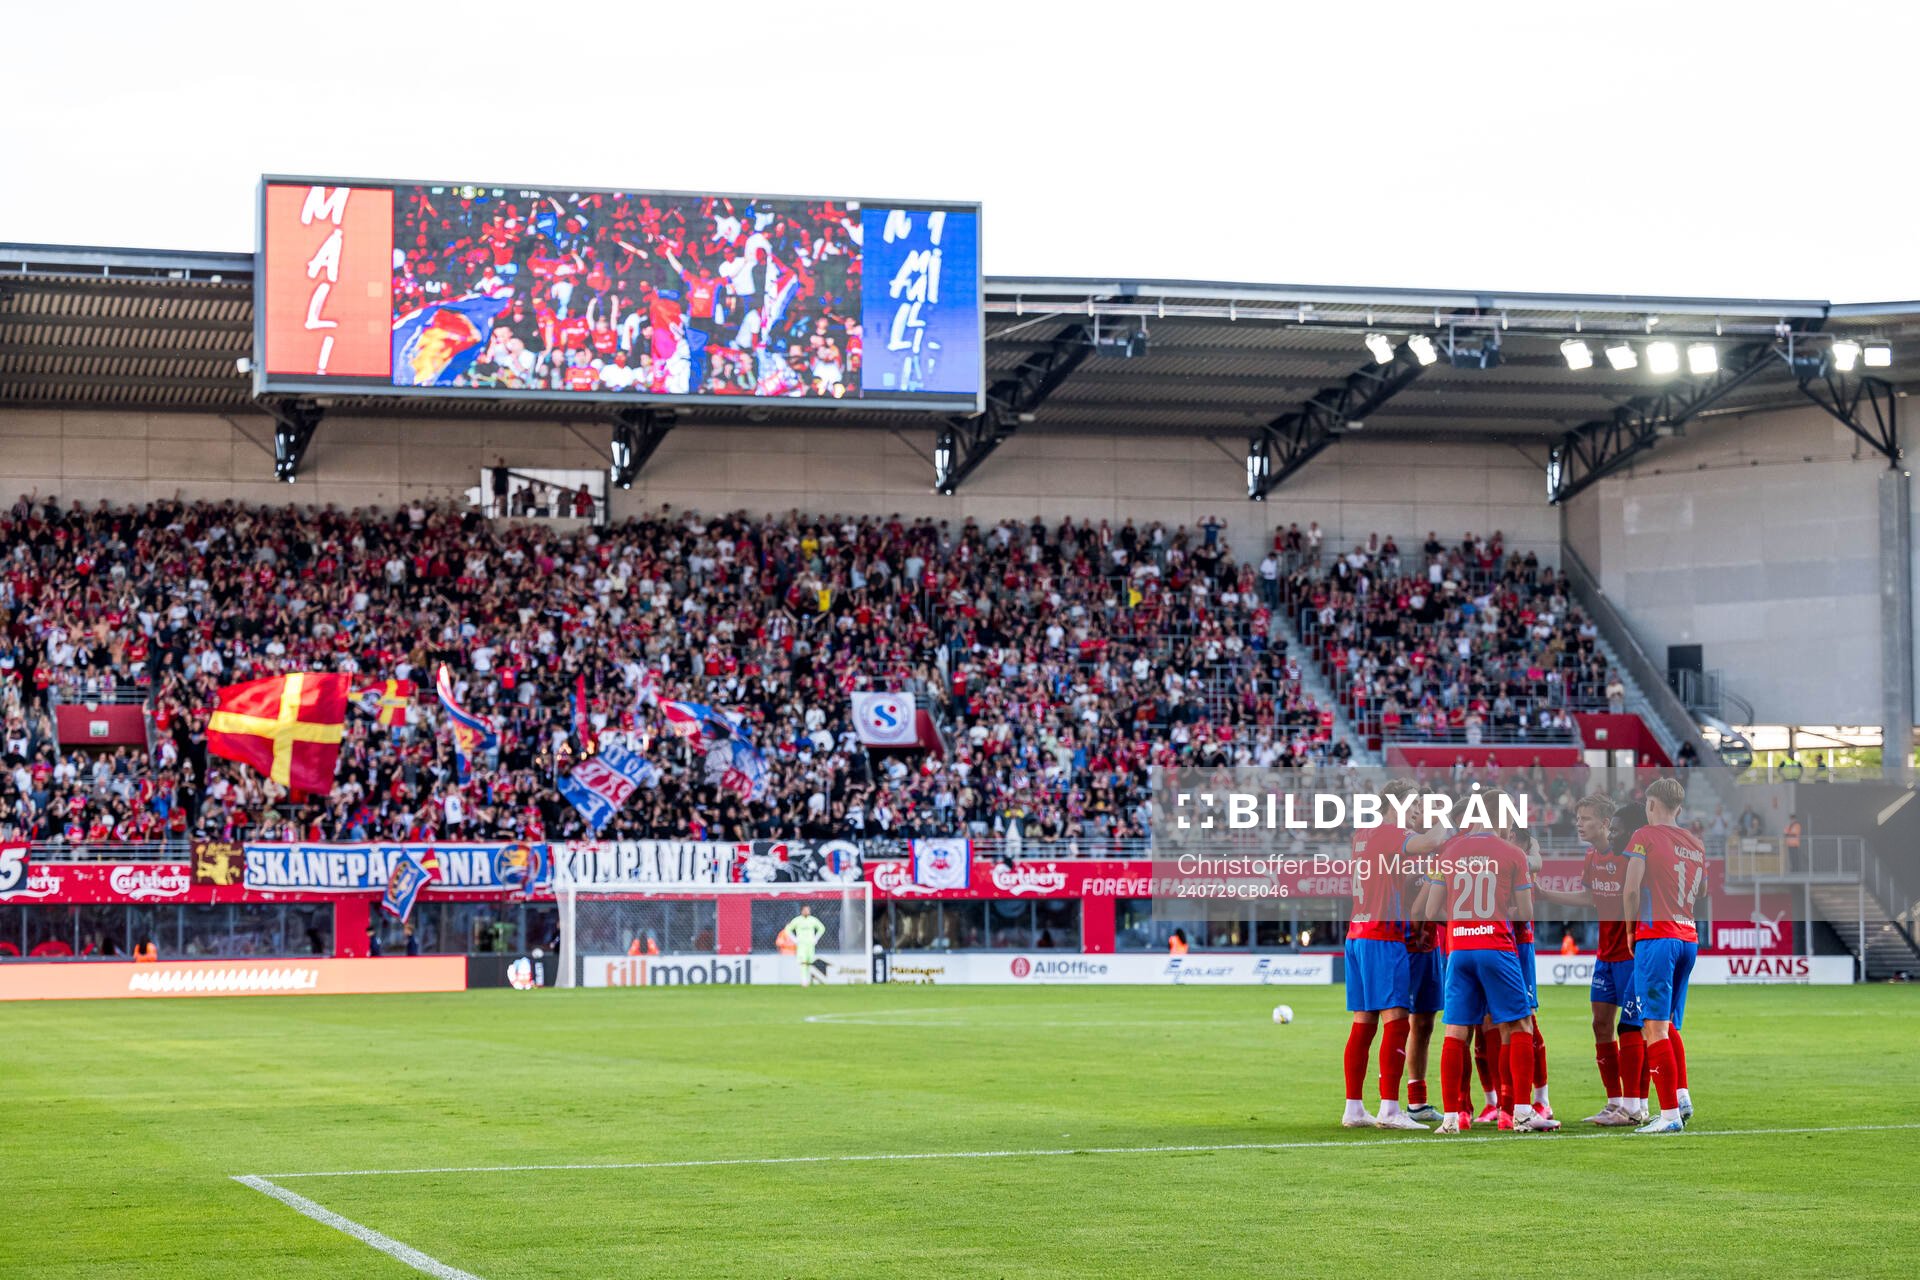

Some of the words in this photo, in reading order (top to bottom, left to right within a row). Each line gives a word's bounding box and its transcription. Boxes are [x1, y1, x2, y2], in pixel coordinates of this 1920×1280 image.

[109, 865, 191, 898] Carlsberg
[991, 863, 1067, 896] Carlsberg
[1081, 877, 1160, 896] FOREVER
[1673, 861, 1703, 914] 14
[1452, 871, 1497, 920] 20
[1717, 928, 1772, 950] PUMA
[605, 958, 752, 987] tillmobil
[1034, 960, 1108, 976] AllOffice
[1728, 957, 1810, 977] WANS
